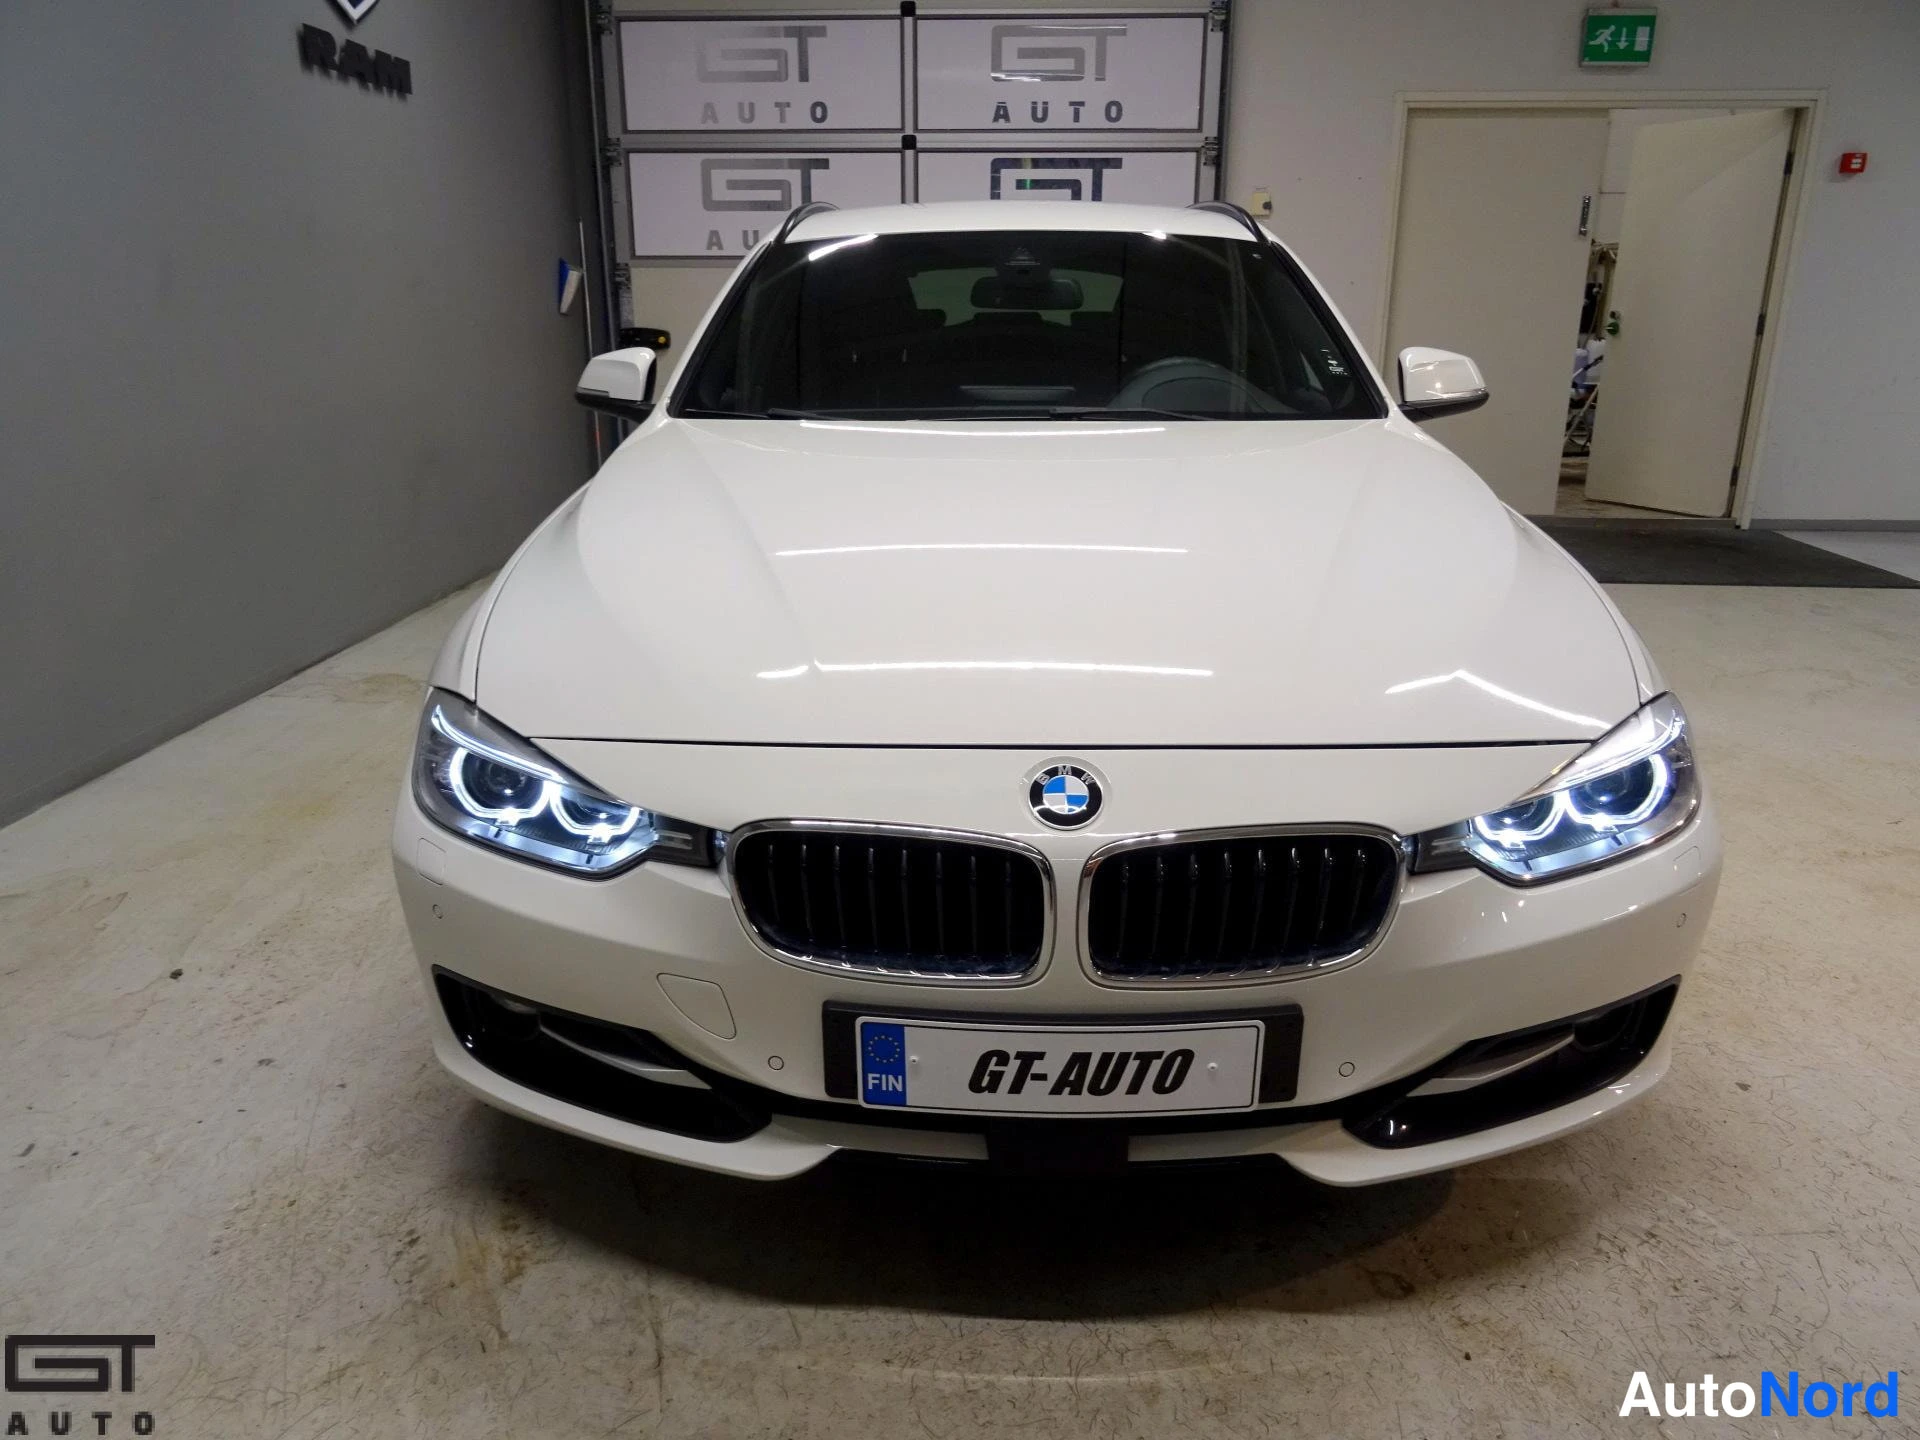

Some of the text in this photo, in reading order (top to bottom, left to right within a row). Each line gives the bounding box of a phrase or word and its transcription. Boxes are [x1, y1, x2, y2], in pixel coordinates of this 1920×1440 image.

[991, 24, 1126, 82] GT
[701, 101, 828, 124] AUTO
[992, 100, 1123, 123] AUTO
[701, 158, 829, 212] GT
[706, 229, 760, 251] AU
[1036, 764, 1097, 785] BMW
[867, 1073, 903, 1091] FIN
[968, 1048, 1195, 1095] GT-AUTO
